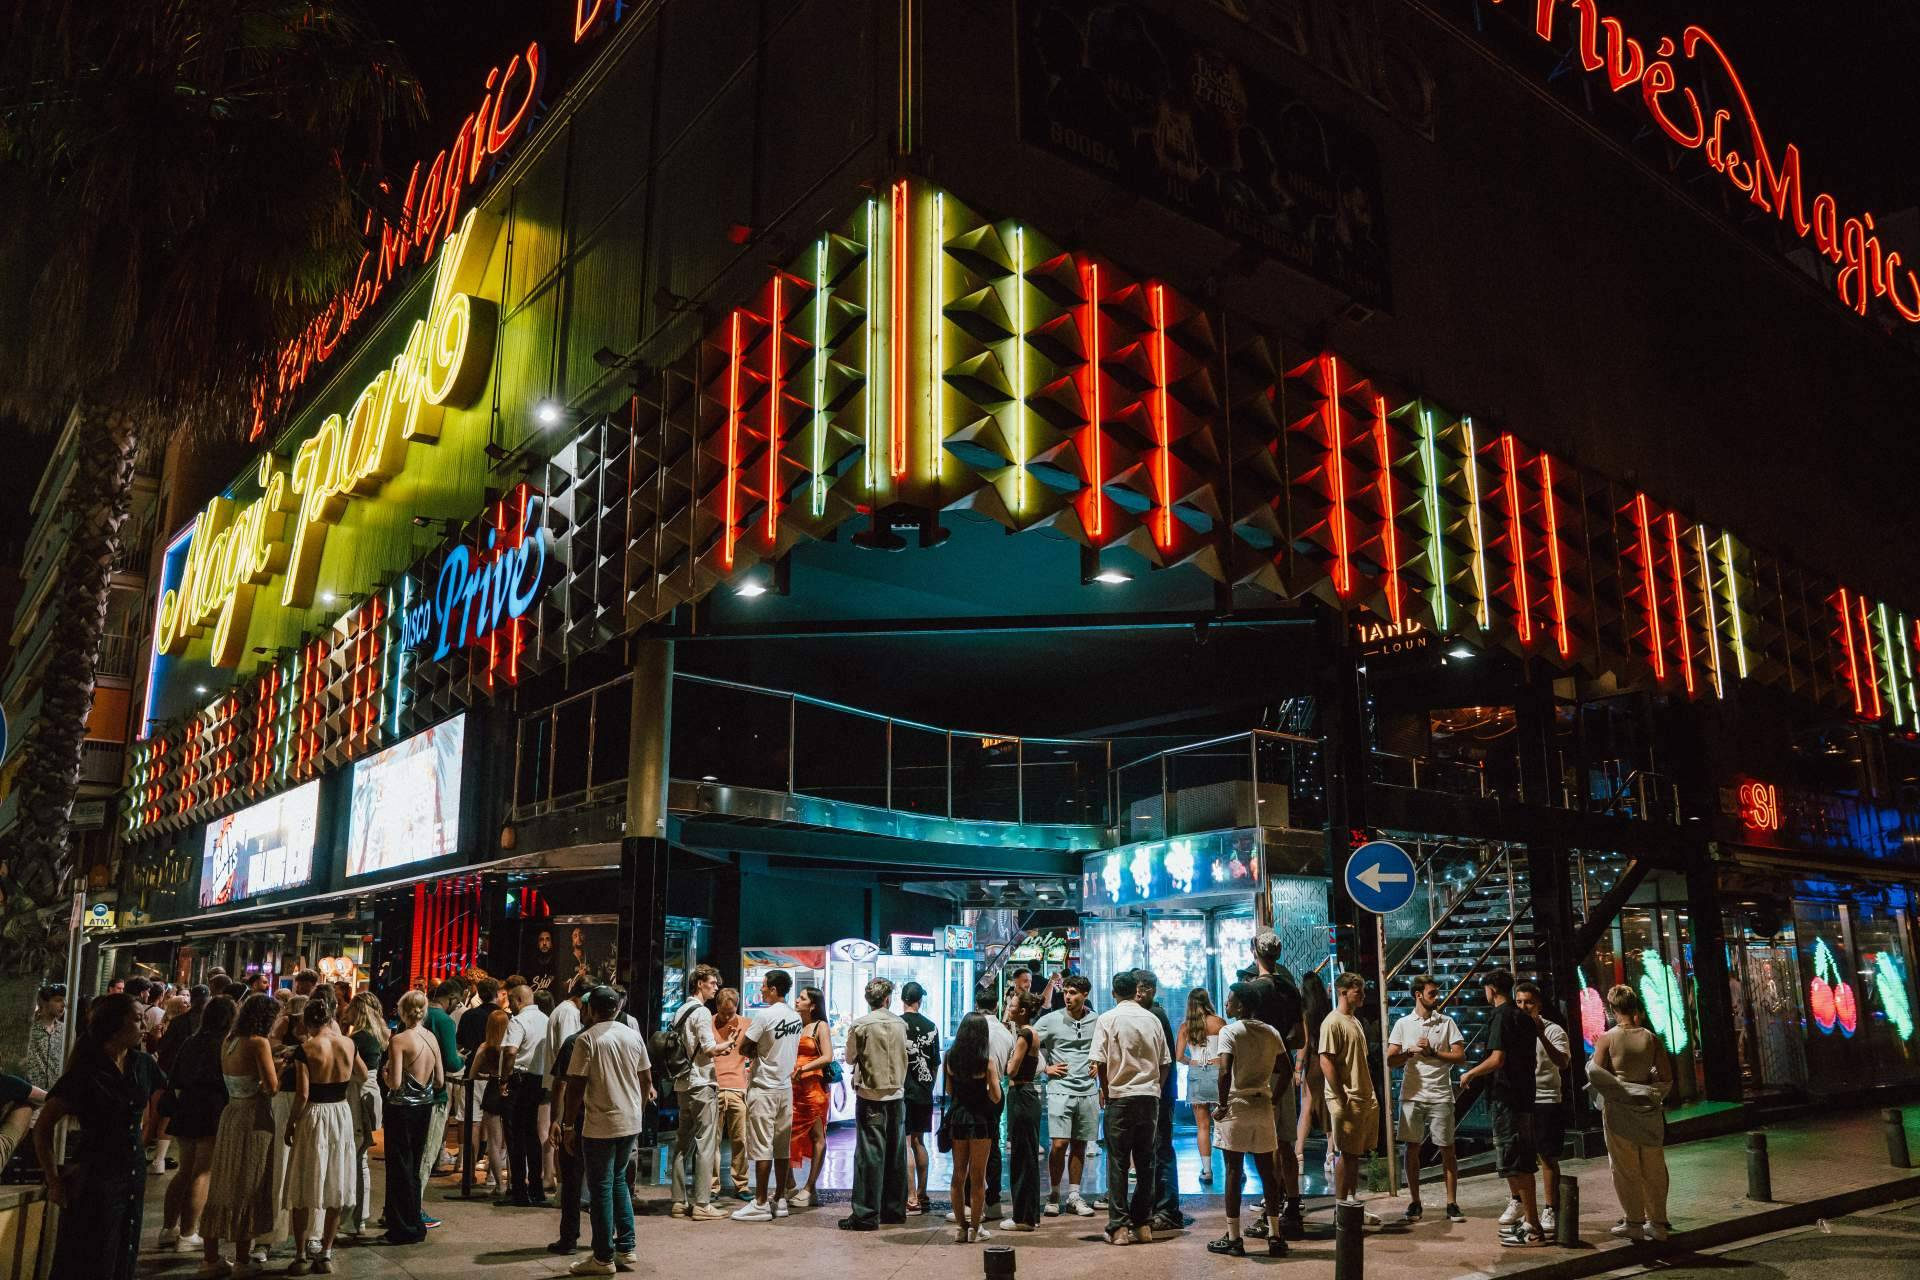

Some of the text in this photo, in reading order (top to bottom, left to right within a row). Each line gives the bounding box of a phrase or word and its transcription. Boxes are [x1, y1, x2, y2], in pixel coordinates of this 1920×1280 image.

[1536, 0, 1703, 148] ivé
[1706, 109, 1752, 191] de
[1683, 26, 1920, 322] Magic
[157, 451, 284, 667] Magic
[401, 496, 545, 663] DISCO Privé
[89, 918, 110, 926] ATM
